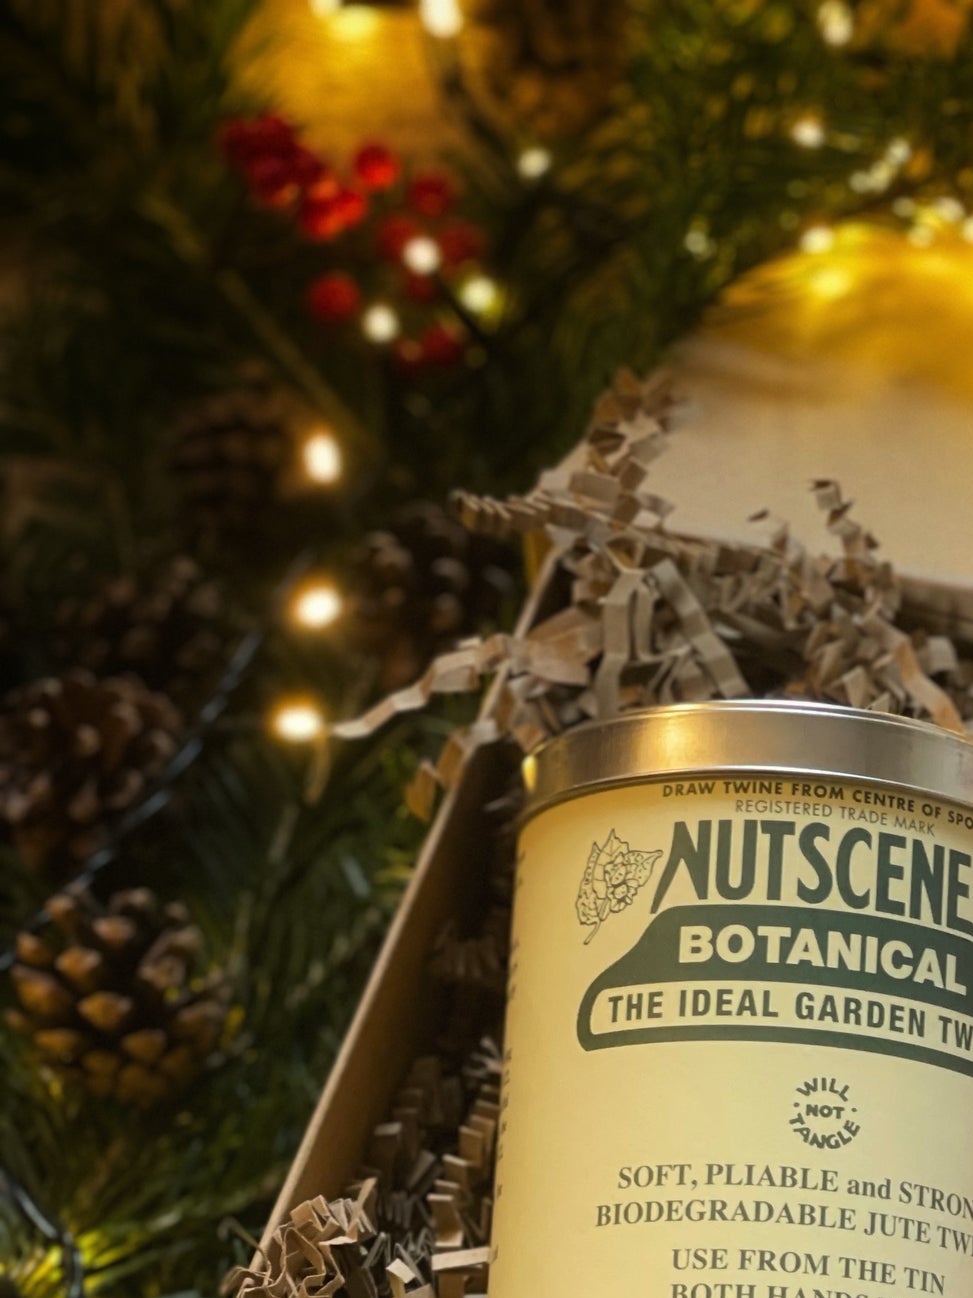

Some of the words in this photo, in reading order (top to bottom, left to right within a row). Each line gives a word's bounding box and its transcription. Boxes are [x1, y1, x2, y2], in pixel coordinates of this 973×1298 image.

[662, 781, 716, 797] DRAW
[723, 781, 783, 795] TWINE
[792, 783, 844, 800] FROM
[852, 789, 915, 813] CENTRE
[922, 803, 941, 819] OF
[735, 799, 832, 817] REGISTERED
[839, 806, 888, 826] TRADE
[893, 817, 936, 837] MARK
[678, 924, 967, 996] BOTANICAL
[607, 991, 664, 1023] THE
[678, 988, 779, 1018] IDEAL
[795, 991, 926, 1039] GARDEN
[796, 1077, 850, 1102] WILL
[789, 1112, 861, 1149] TANGLE
[805, 1104, 845, 1119] NOT
[618, 1164, 699, 1191] SOFT,
[705, 1164, 839, 1194] PLIABLE
[846, 1177, 891, 1200] and
[595, 1198, 857, 1232] BIODEGRADABLE
[863, 1212, 931, 1245] JUTE
[671, 1247, 728, 1271] USE
[738, 1249, 830, 1276] FROM
[837, 1256, 897, 1286] THE
[903, 1267, 946, 1296] TIN
